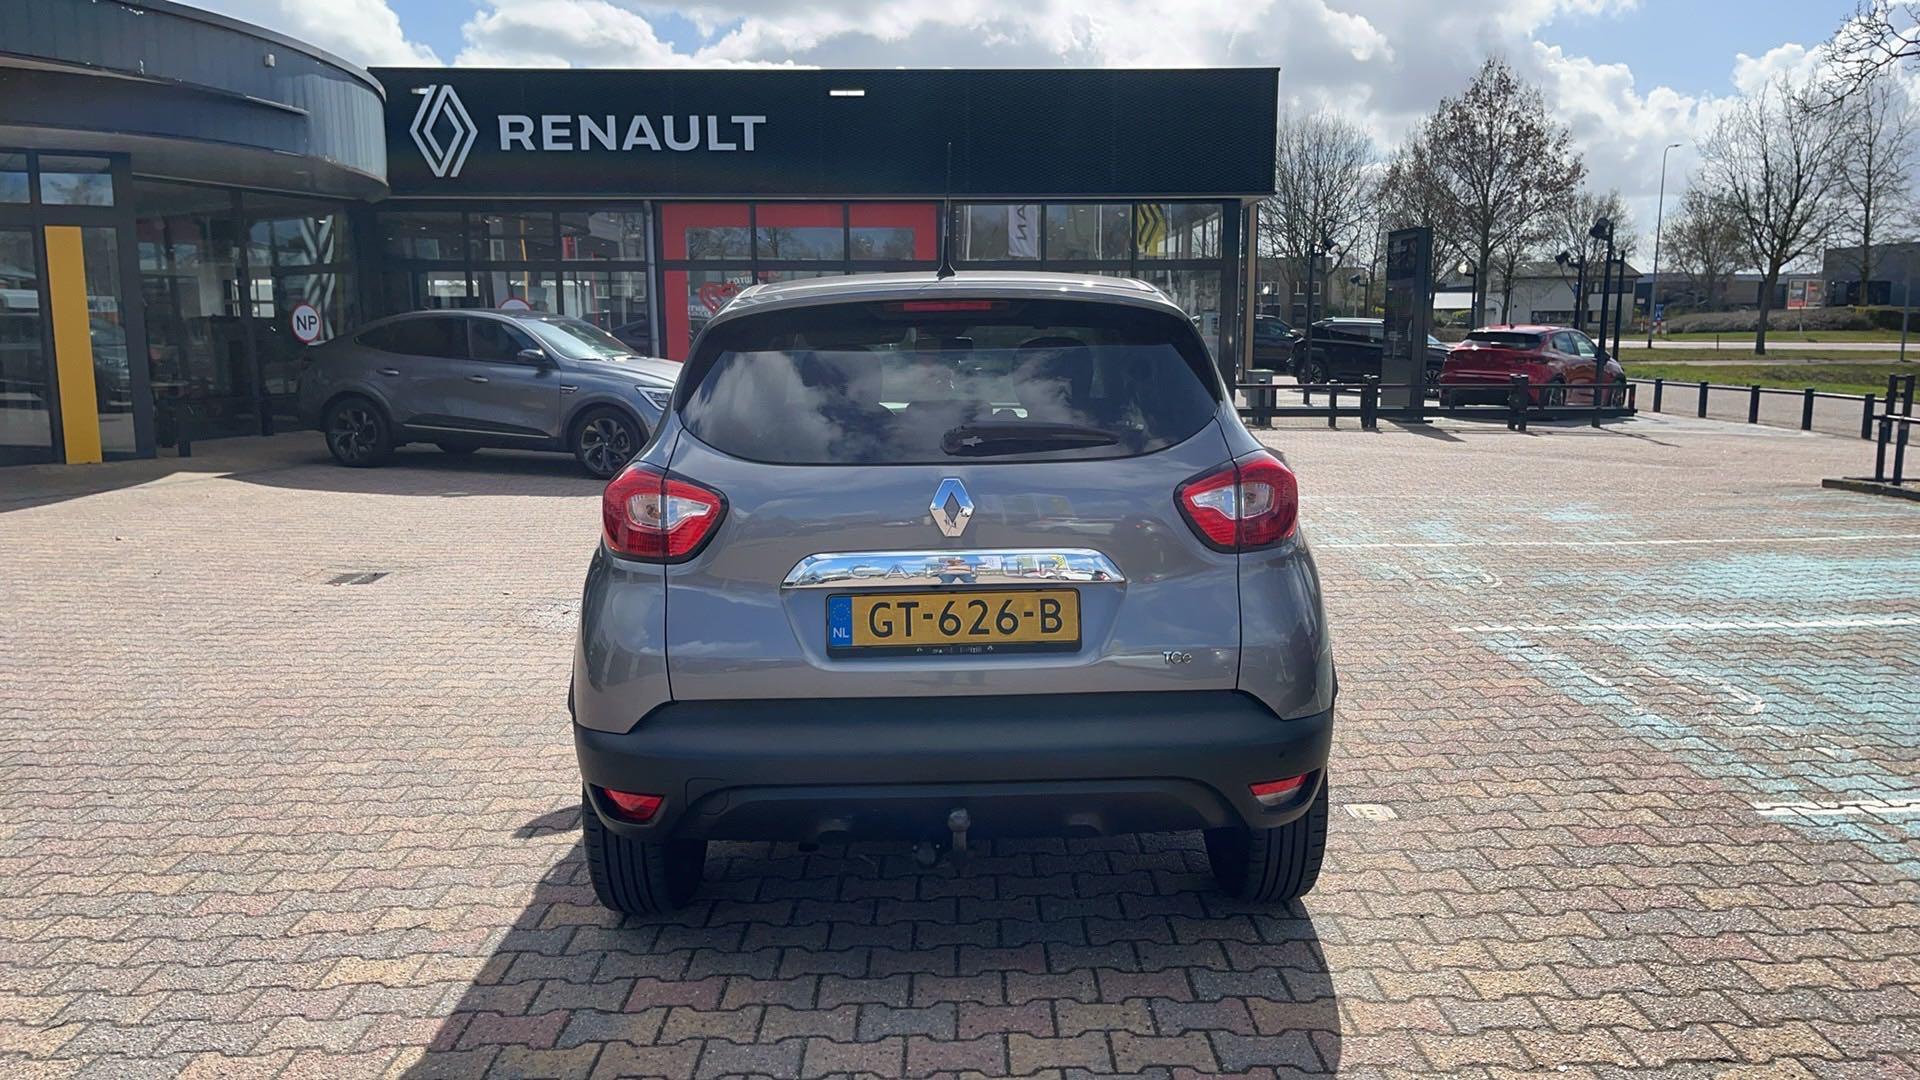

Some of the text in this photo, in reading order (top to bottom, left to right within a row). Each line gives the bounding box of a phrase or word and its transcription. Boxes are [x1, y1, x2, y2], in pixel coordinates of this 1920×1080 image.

[498, 115, 766, 151] RENAULT
[296, 315, 318, 330] NP
[868, 598, 1063, 638] GT-626-B
[833, 627, 850, 638] NL
